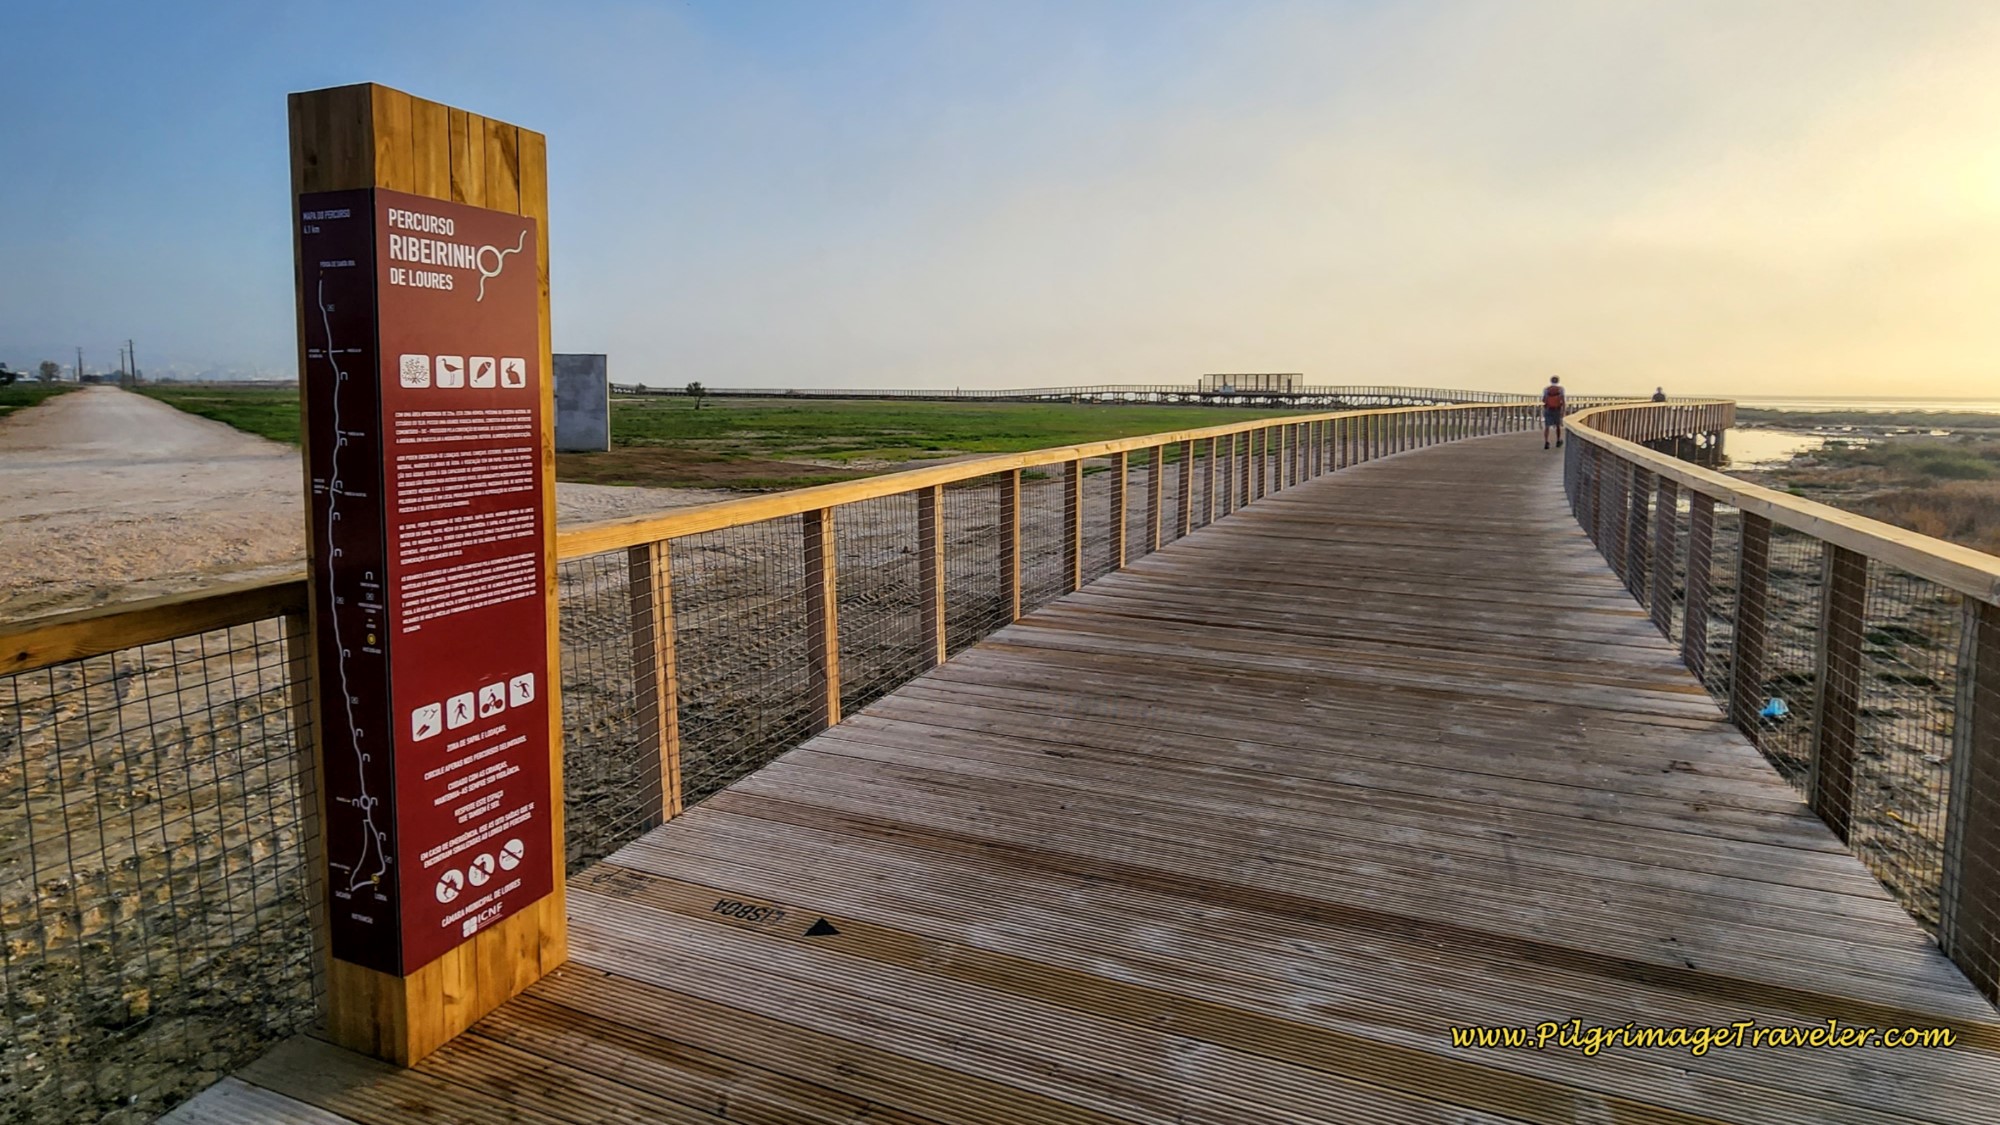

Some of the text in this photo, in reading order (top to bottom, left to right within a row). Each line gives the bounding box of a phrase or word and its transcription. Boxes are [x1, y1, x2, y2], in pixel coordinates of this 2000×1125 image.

[388, 208, 455, 236] PERCURSO
[389, 234, 503, 277] RIBEIRINHO
[390, 267, 453, 290] DE LOURES
[465, 894, 493, 914] MUNICIPAL
[477, 901, 503, 923] ICNF
[712, 898, 786, 924] LISBOA
